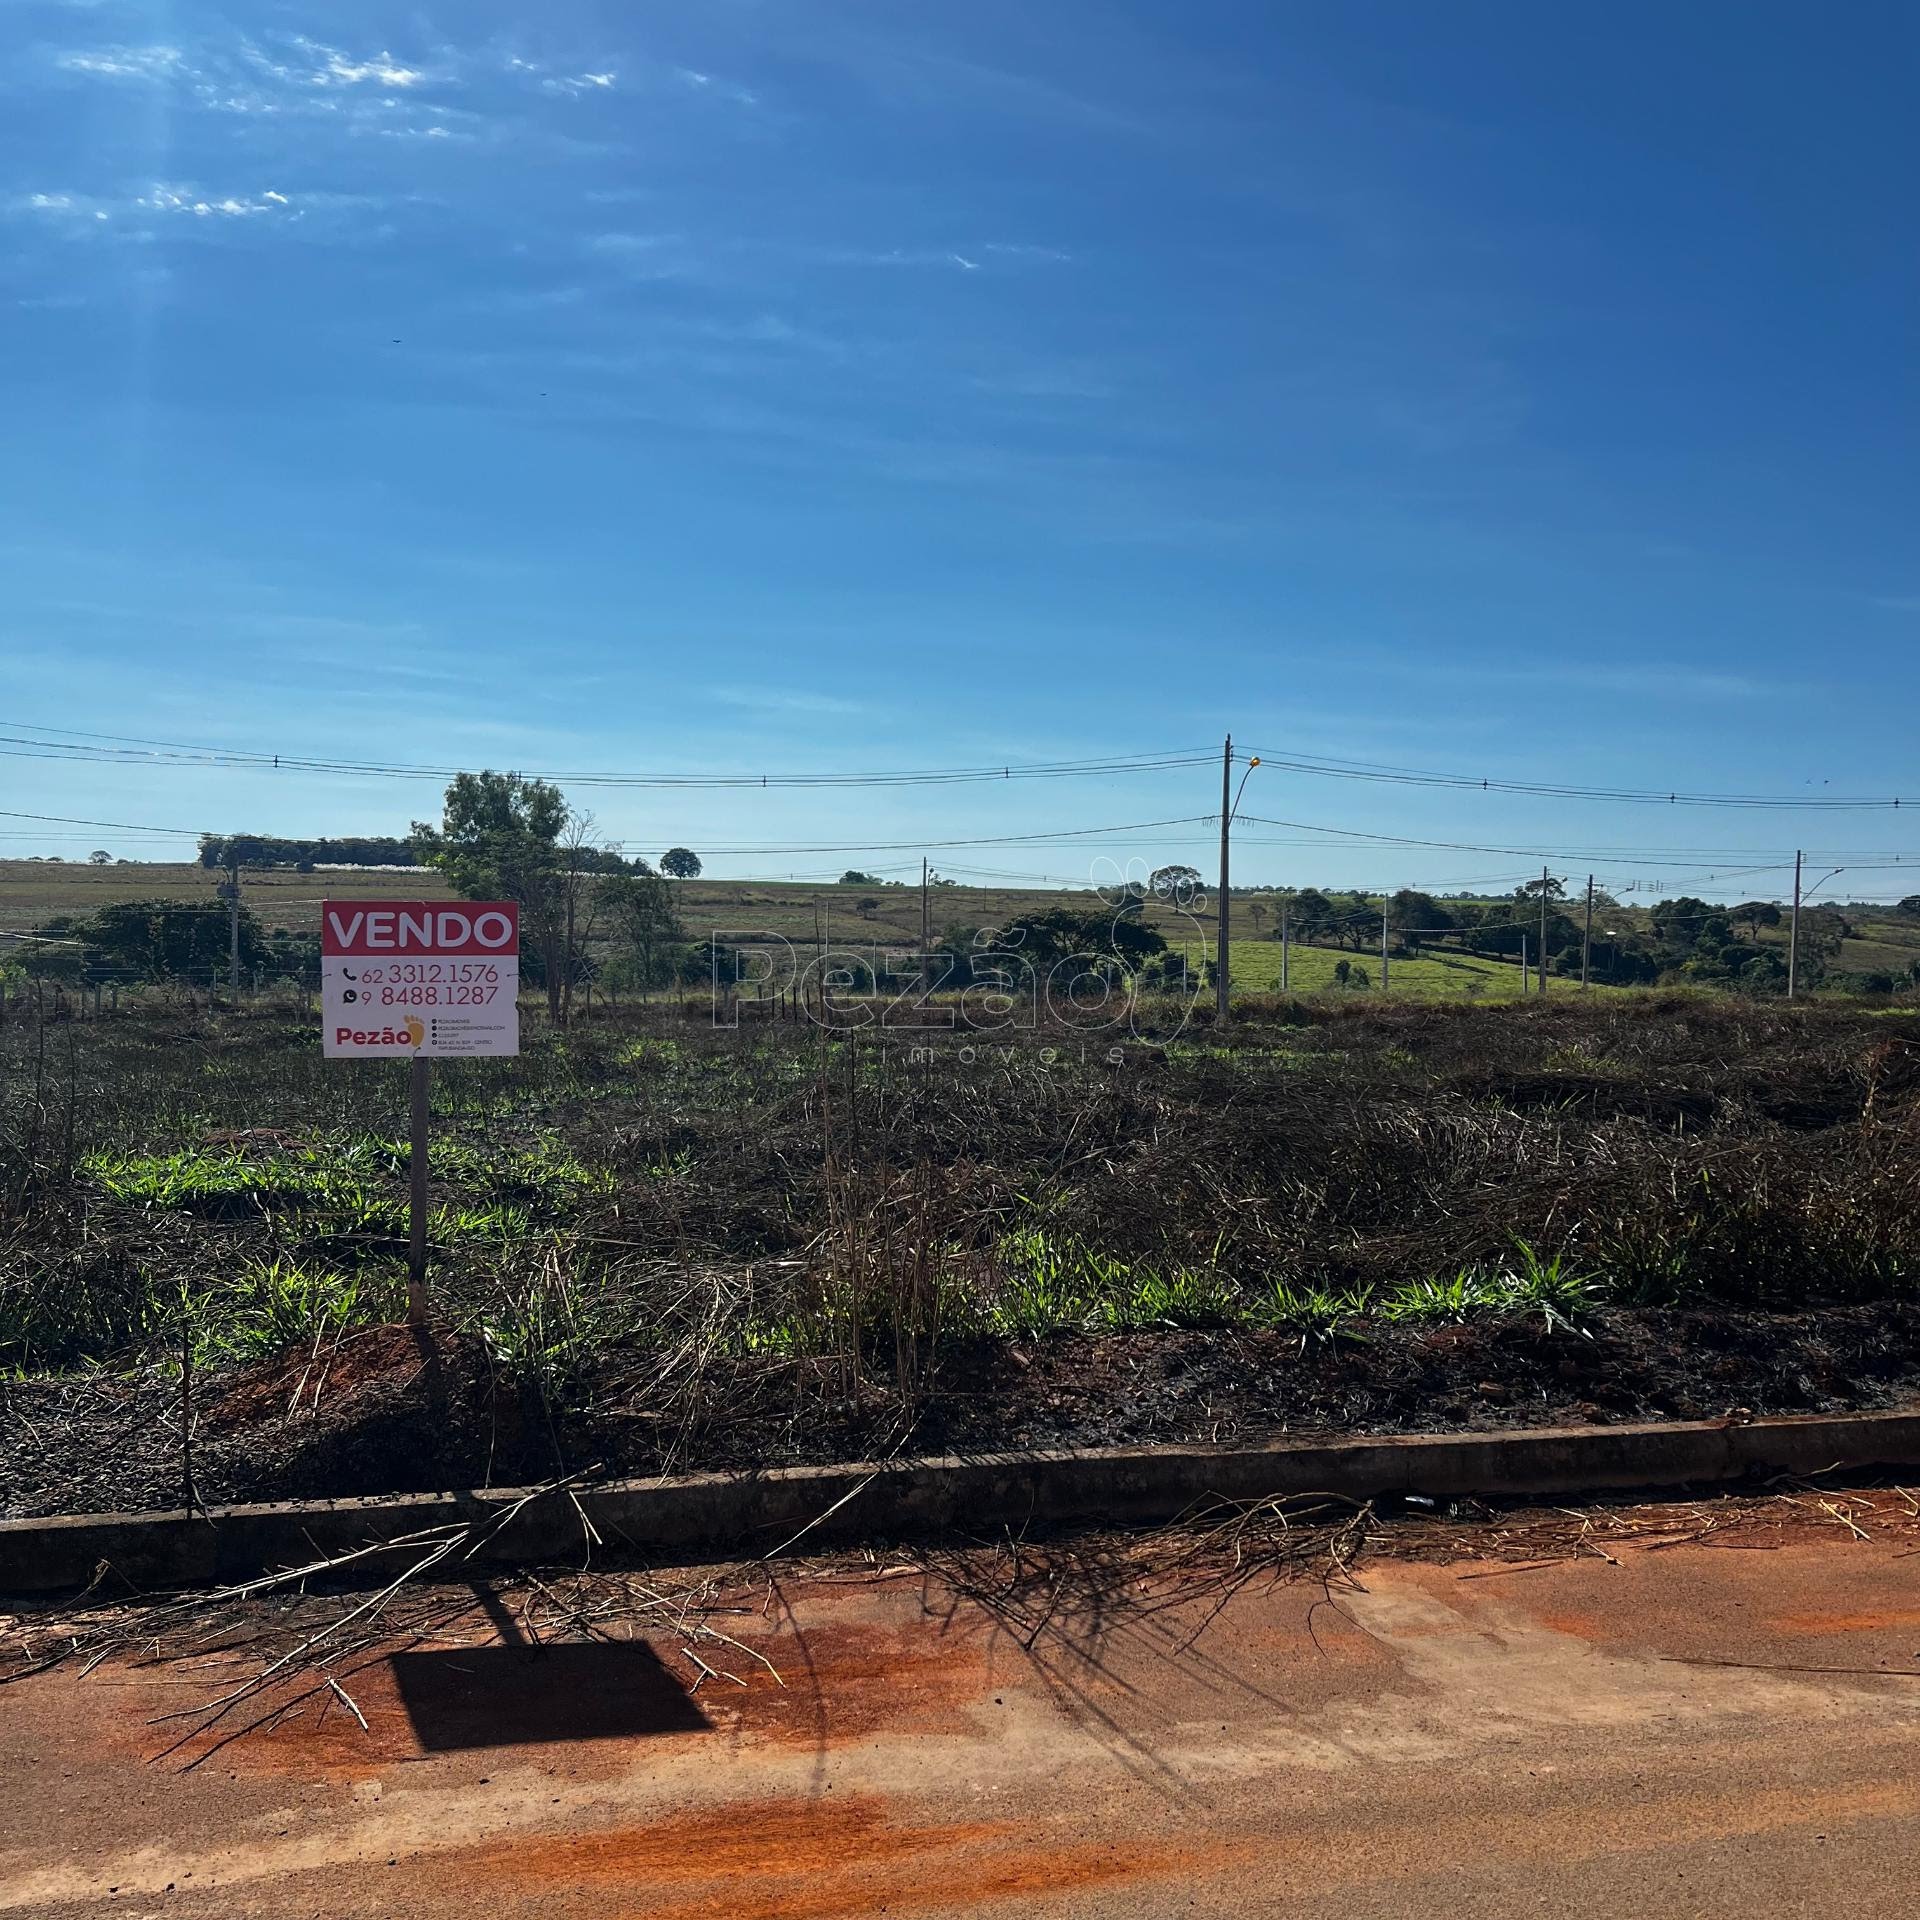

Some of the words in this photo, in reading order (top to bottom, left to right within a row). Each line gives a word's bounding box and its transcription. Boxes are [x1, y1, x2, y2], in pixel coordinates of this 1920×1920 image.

[328, 911, 513, 949] VENDO
[361, 969, 383, 984] 62
[388, 964, 499, 984] 3312.1576
[361, 991, 372, 1006] 9
[381, 986, 499, 1006] 8488.1287
[336, 1026, 412, 1046] Pezão
